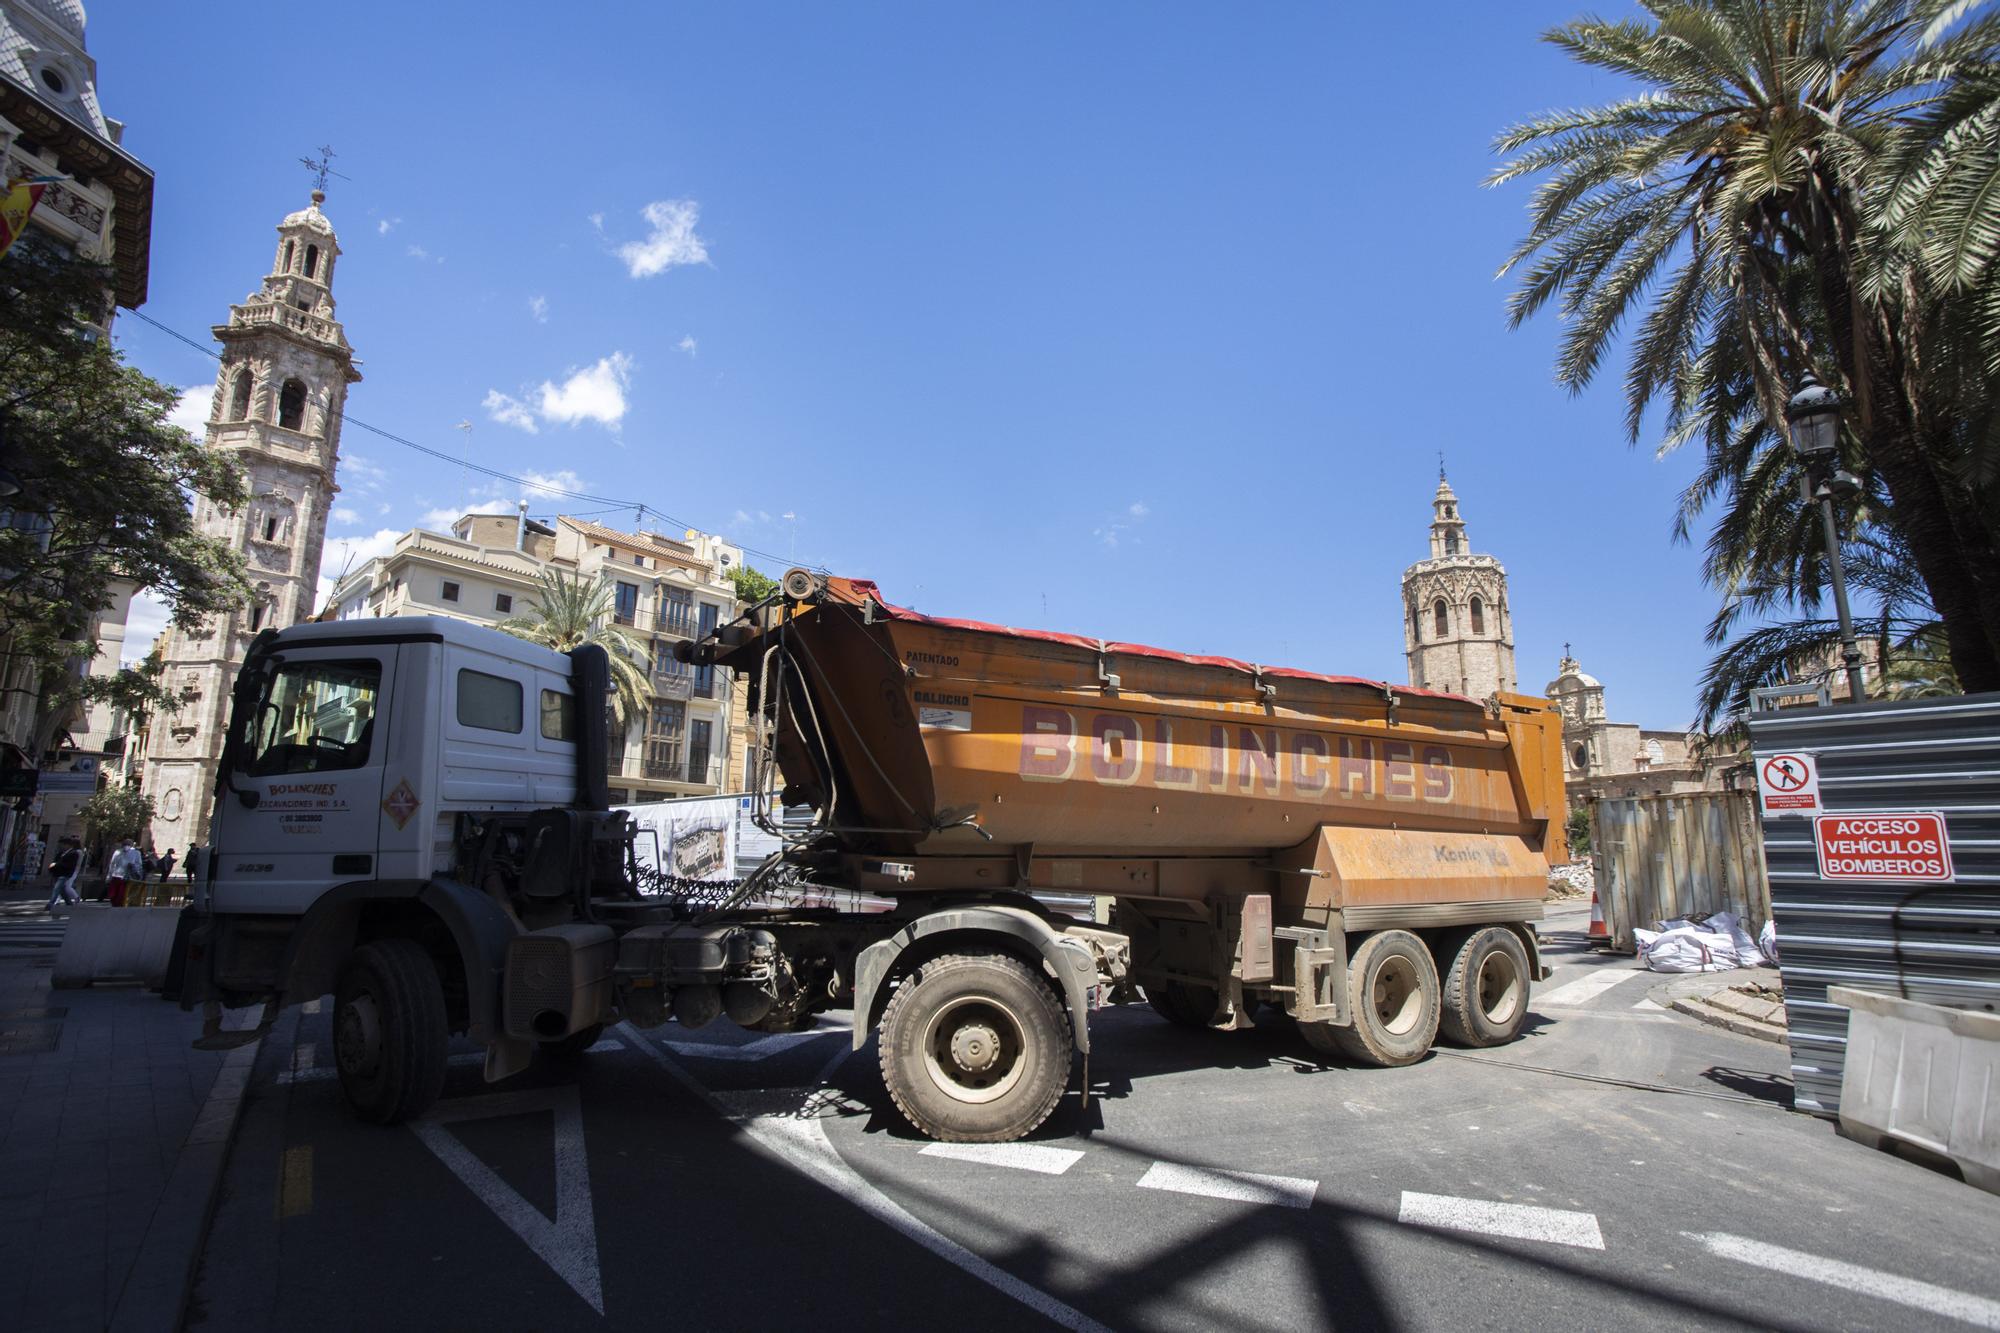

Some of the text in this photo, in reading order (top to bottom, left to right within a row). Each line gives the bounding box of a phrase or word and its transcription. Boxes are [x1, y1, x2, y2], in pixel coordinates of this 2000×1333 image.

[906, 651, 960, 667] PATENTADO
[1017, 706, 1455, 804] BOLINCHES
[269, 783, 337, 796] BOLINCHES
[1836, 820, 1920, 835] ACCESO
[1826, 837, 1938, 854] VEHÍCULOS
[1828, 858, 1942, 874] BOMBEROS
